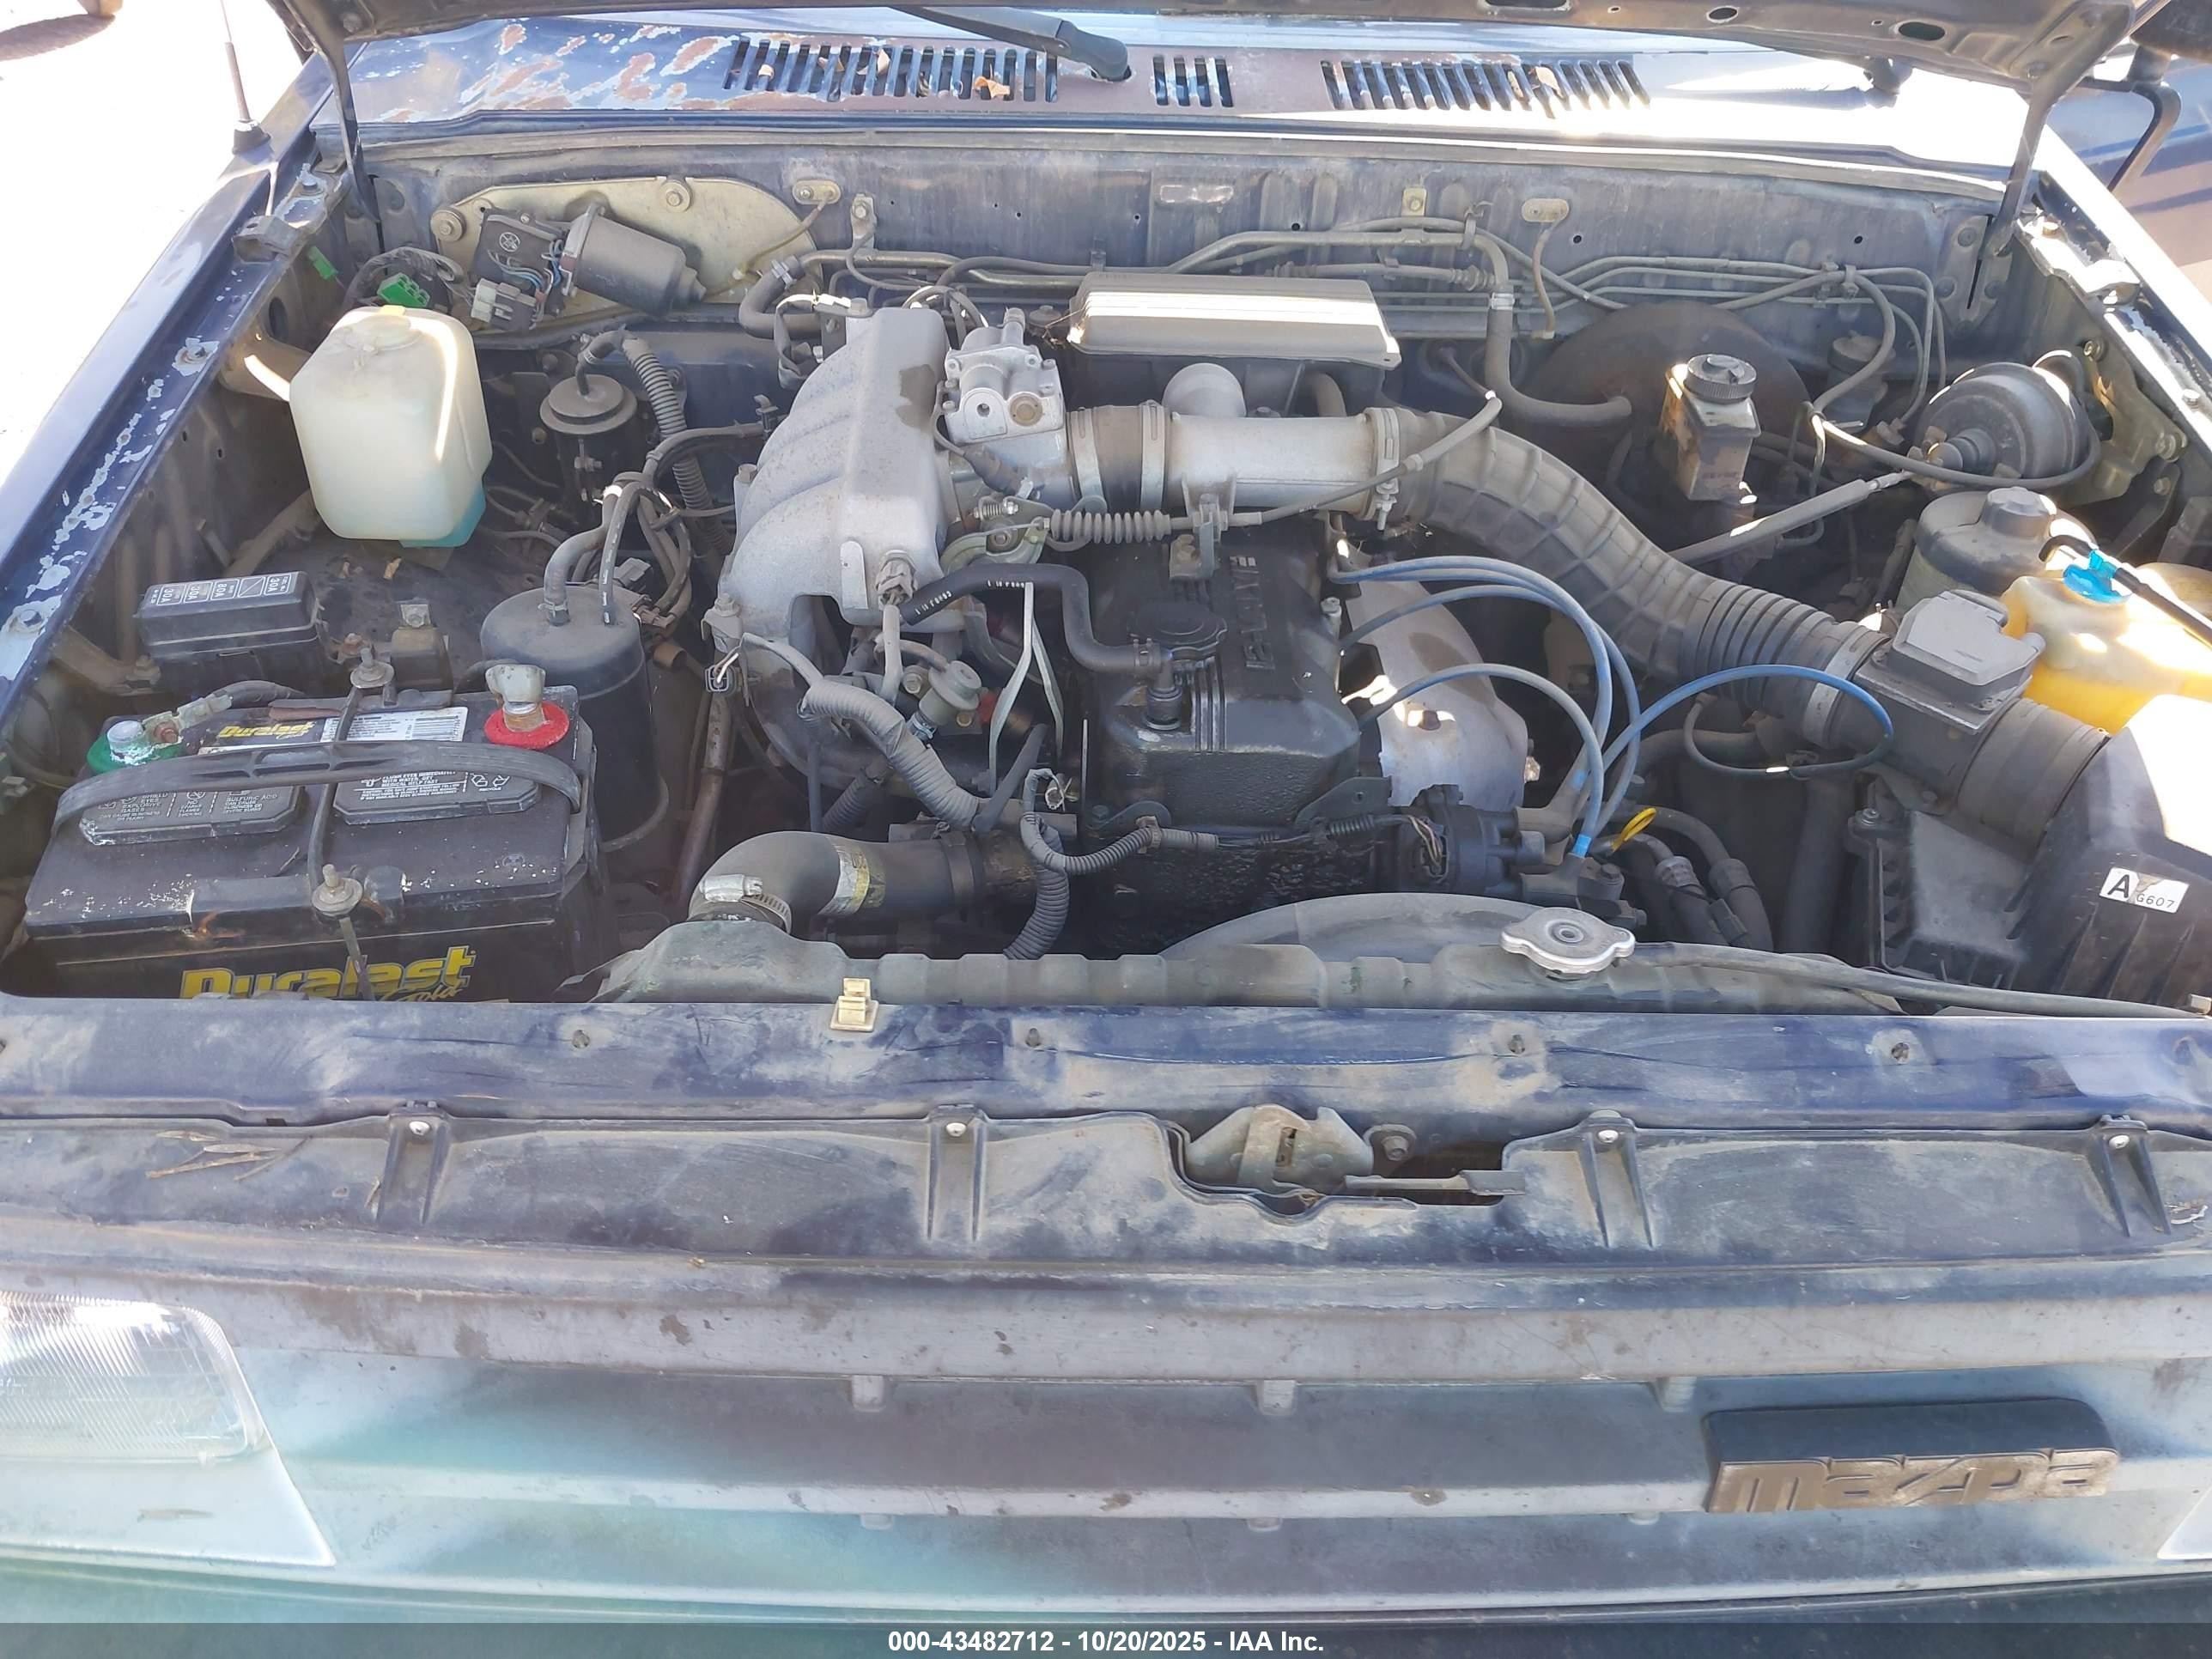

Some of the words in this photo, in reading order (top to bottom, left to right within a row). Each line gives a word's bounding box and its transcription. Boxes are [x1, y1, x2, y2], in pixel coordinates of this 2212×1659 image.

[267, 577, 280, 592] 30A
[161, 588, 173, 603] 30A
[187, 586, 200, 600] 30A
[219, 721, 315, 738] Duralast
[2107, 874, 2130, 898] A
[2136, 893, 2175, 908] G607
[179, 945, 475, 1000] Duralast
